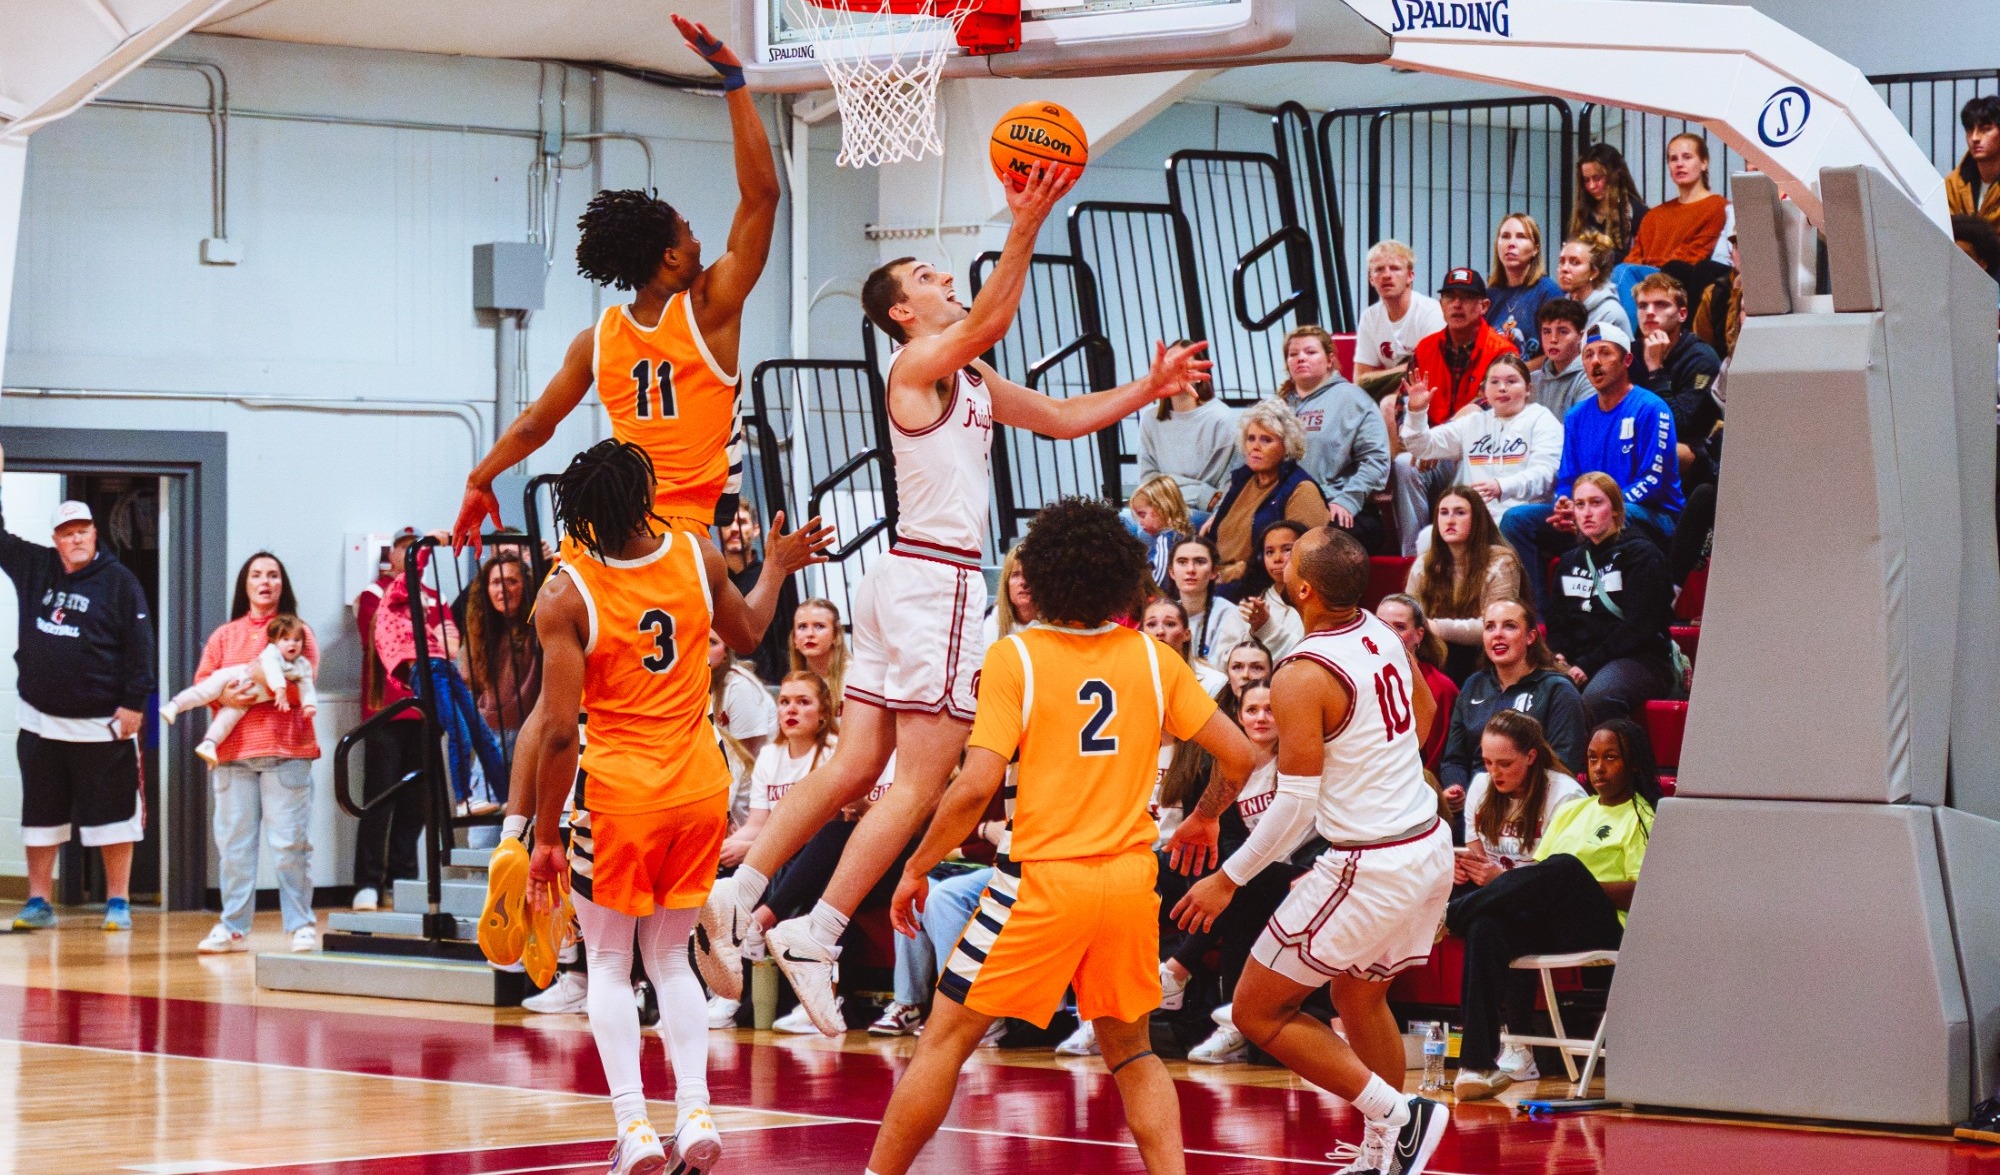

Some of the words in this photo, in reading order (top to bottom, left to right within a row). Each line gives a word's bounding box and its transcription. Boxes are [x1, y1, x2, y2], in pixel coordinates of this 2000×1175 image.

[1391, 0, 1509, 37] SPALDING
[769, 44, 814, 62] SPALDING
[1009, 124, 1071, 157] Wilson
[631, 358, 679, 420] 11
[1624, 474, 1658, 503] LET'S
[1651, 454, 1664, 474] GO
[1658, 411, 1670, 450] DUKE
[638, 607, 678, 674] 3
[1077, 678, 1119, 756] 2
[1374, 662, 1411, 742] 10
